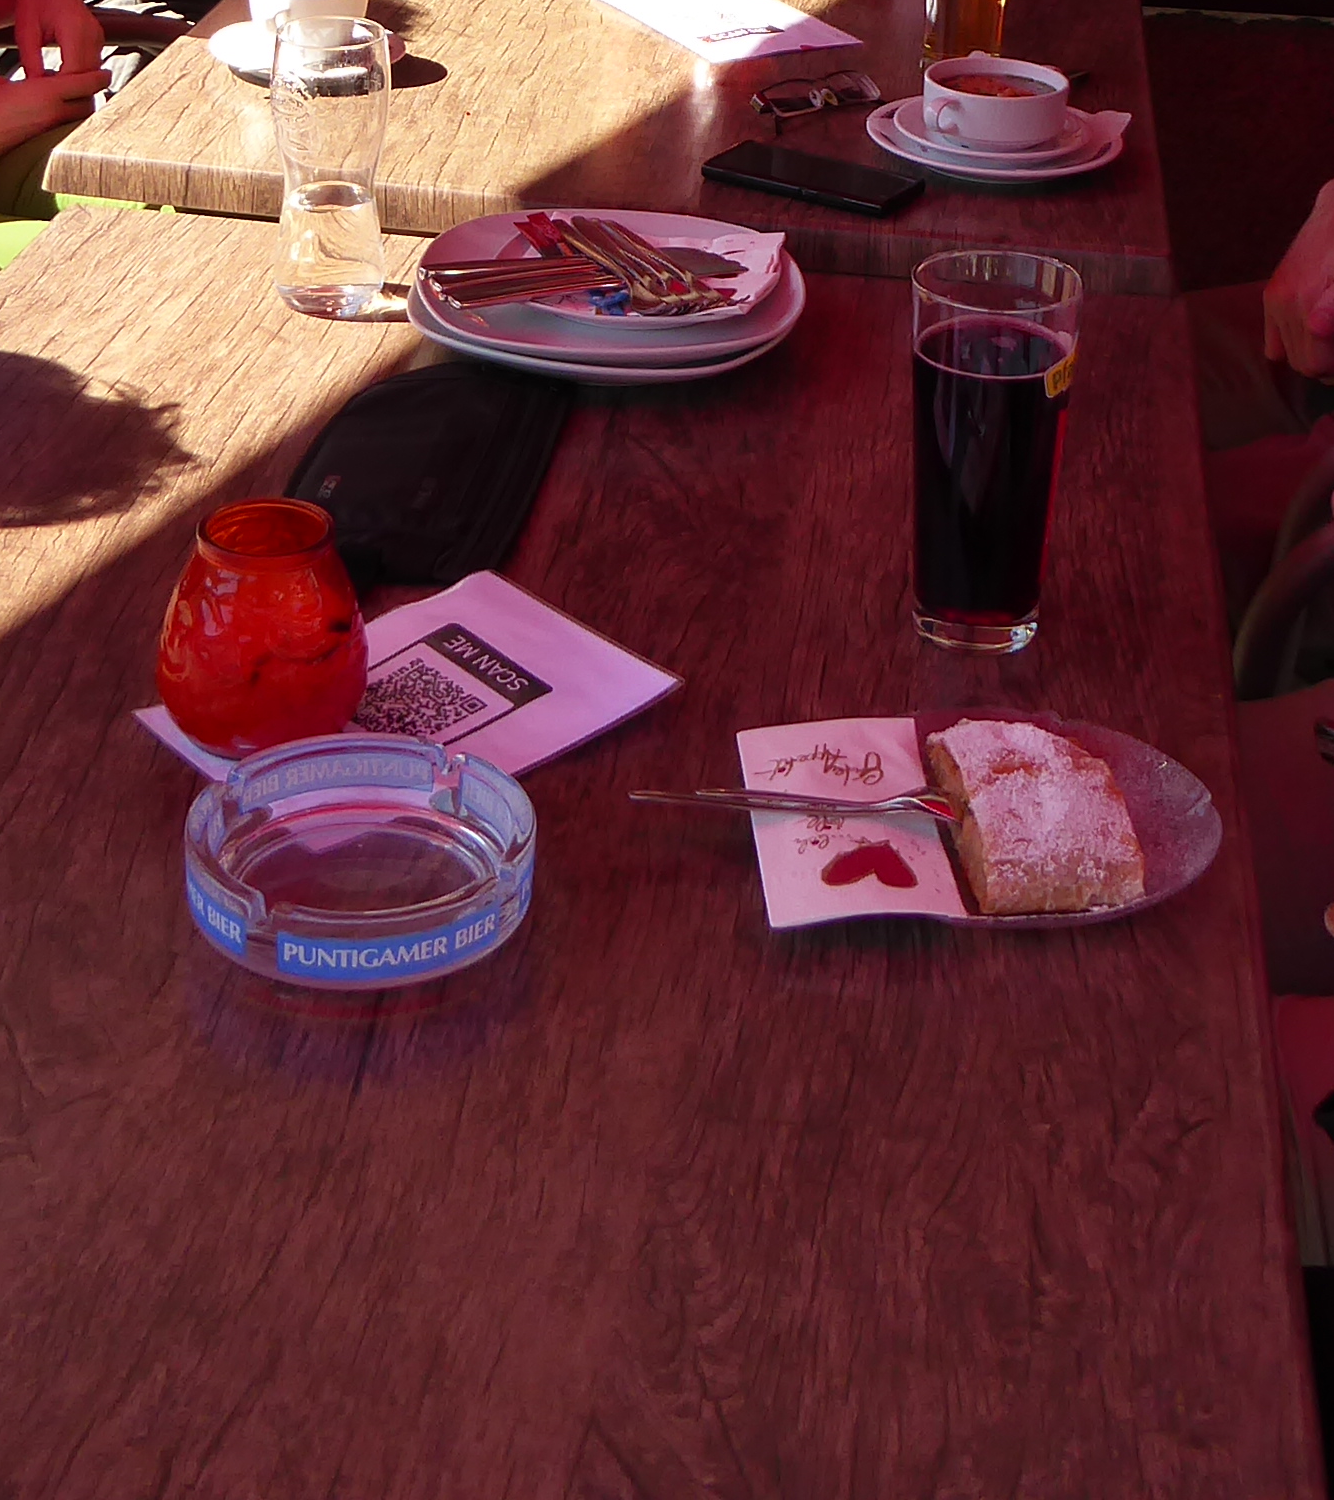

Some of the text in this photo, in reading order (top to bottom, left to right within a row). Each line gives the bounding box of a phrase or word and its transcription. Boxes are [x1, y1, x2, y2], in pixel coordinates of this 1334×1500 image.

[442, 634, 529, 691] SCAN ME
[207, 904, 243, 946] BIER
[283, 912, 497, 969] PUNTIGAMER BIER
